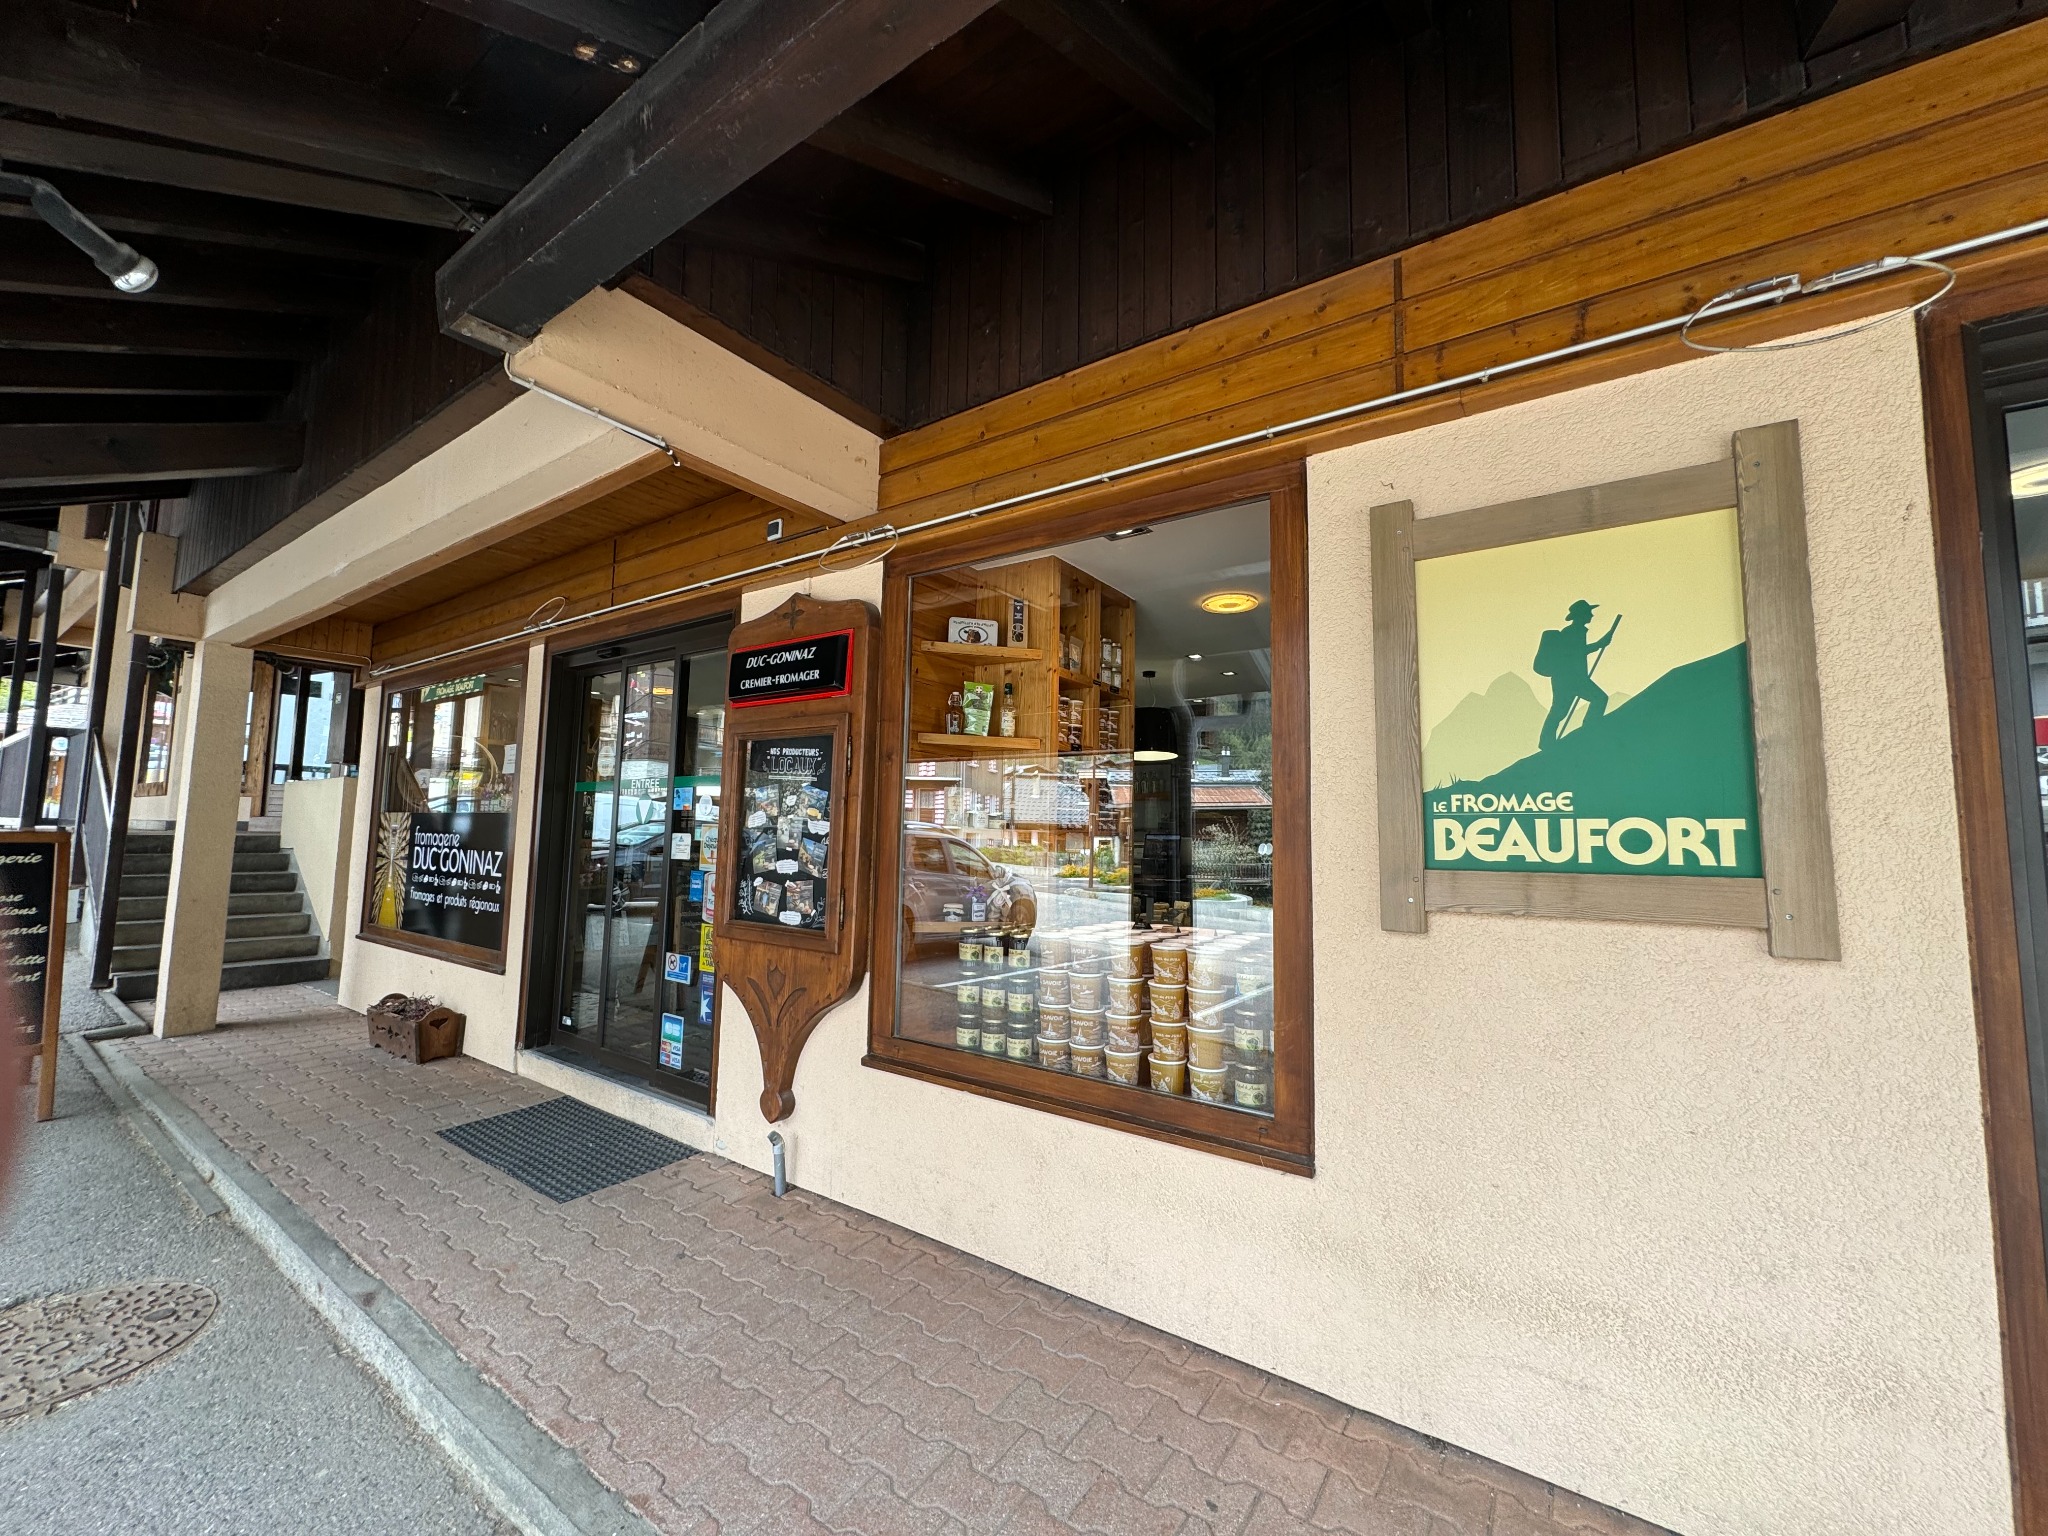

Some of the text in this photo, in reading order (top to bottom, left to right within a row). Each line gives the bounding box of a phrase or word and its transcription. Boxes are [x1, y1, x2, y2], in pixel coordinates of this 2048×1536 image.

[745, 646, 817, 668] DUC-GONINAZ
[740, 669, 820, 690] CREMIER-FROMAGER
[631, 778, 660, 789] ENTREE
[1433, 792, 1574, 813] LE FROMAGE
[415, 825, 460, 853] fromagerie
[1433, 817, 1747, 867] BEAUFORT
[413, 846, 504, 878] DUC GONINAZ
[410, 886, 500, 915] fromages et produits régionaux
